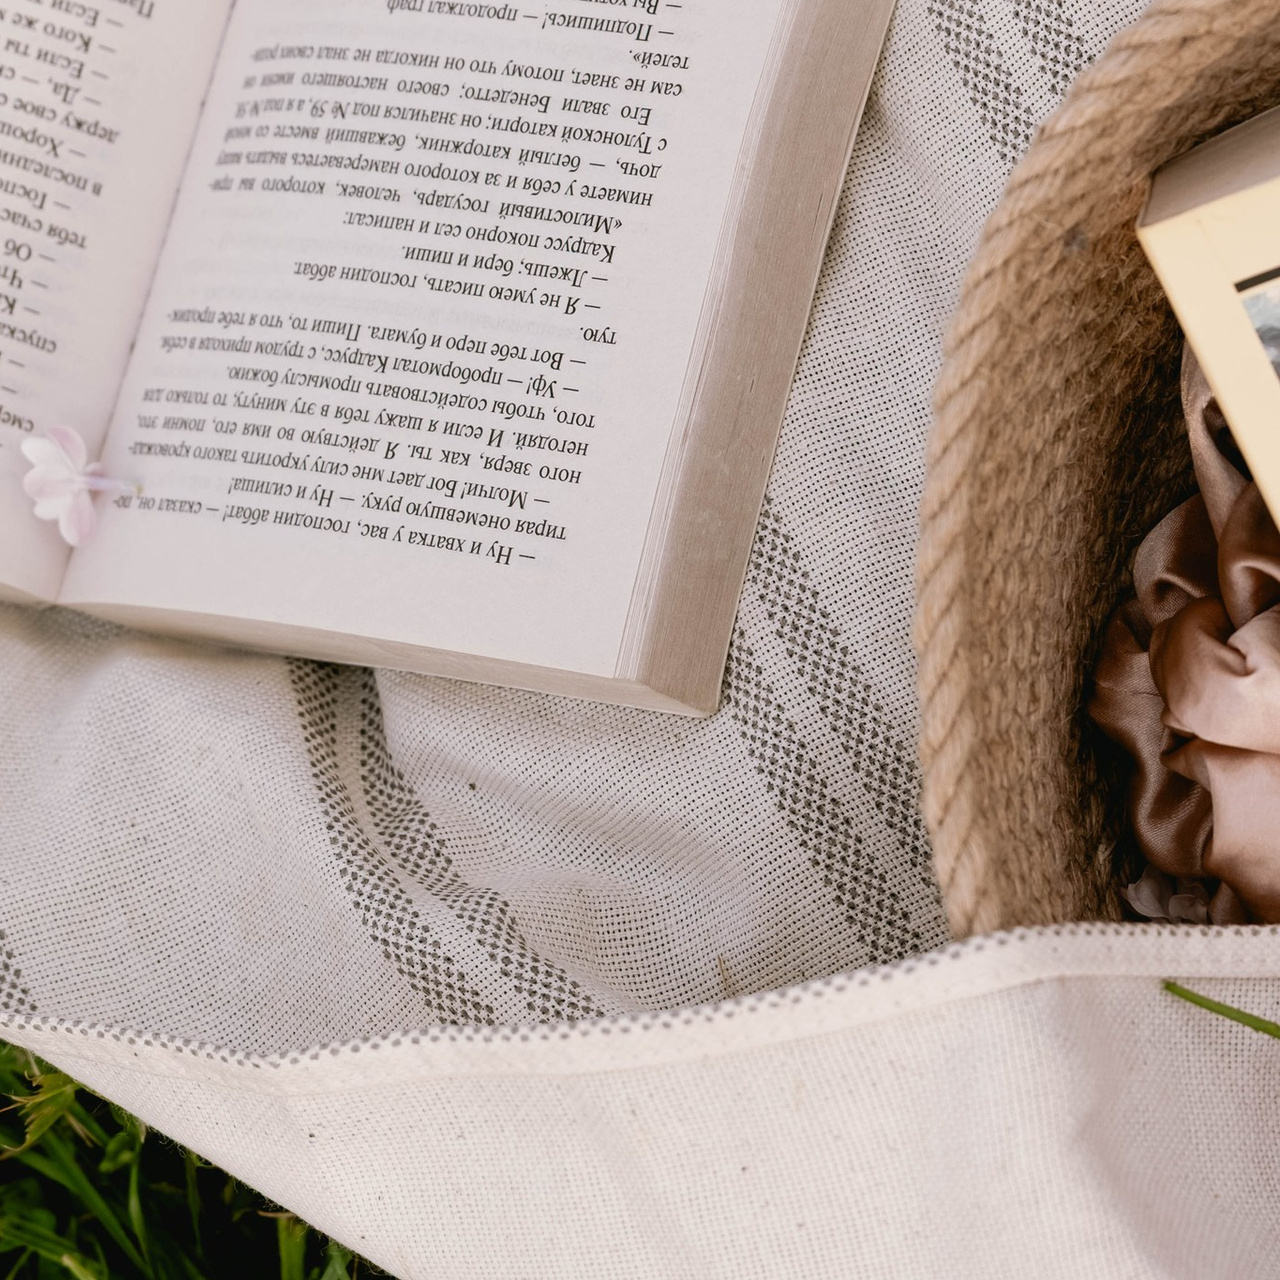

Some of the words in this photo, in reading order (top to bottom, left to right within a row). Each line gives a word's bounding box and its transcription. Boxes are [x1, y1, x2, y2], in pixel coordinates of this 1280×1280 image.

[11, 12, 38, 29] же
[426, 0, 518, 21] продолжал
[42, 22, 92, 53] Кого
[540, 11, 653, 42] Подпишись!
[3, 37, 29, 57] ты
[35, 48, 84, 79] Если
[468, 59, 497, 74] что
[628, 49, 689, 69] телей».
[500, 59, 564, 82] потому
[570, 68, 620, 89] знает,
[47, 77, 80, 105] Да,
[396, 79, 450, 96] своего
[458, 83, 551, 113] Бенедетто;
[649, 80, 682, 96] сам
[12, 97, 57, 121] свое
[382, 105, 457, 125] значился
[560, 97, 611, 116] звали
[619, 104, 652, 126] Его
[63, 113, 120, 144] держу
[484, 115, 558, 137] каторги;
[414, 134, 511, 159] каторжник,
[560, 125, 652, 155] Тулонской
[517, 148, 581, 173] беглый
[615, 158, 662, 178] дочь,
[403, 162, 480, 184] которого
[521, 176, 561, 196] себя
[579, 184, 653, 206] нимаете
[412, 189, 489, 213] государь,
[433, 221, 462, 237] сел
[498, 202, 622, 234] «Милостивый
[45, 223, 86, 249] тебя
[464, 224, 540, 248] покорно
[3, 238, 32, 262] Об
[401, 245, 454, 264] пиши.
[543, 235, 616, 264] Кадрусс
[472, 252, 514, 277] бери
[517, 258, 588, 288] Лжешь;
[338, 266, 417, 288] господин
[423, 274, 485, 297] писать,
[488, 285, 537, 304] умею
[367, 325, 427, 350] бумага.
[444, 334, 487, 354] перо
[579, 326, 616, 345] тую.
[320, 346, 389, 374] Кадрусс,
[489, 342, 527, 362] тебе
[529, 348, 564, 370] Вот
[391, 356, 503, 385] пробормотал
[364, 381, 488, 411] содействовать
[333, 405, 369, 424] тебя
[373, 407, 423, 430] щажу
[490, 399, 545, 420] чтобы
[552, 405, 595, 428] того,
[300, 427, 380, 453] действую
[442, 420, 483, 439] если
[512, 431, 589, 456] негодяй.
[309, 455, 349, 476] силу
[438, 449, 471, 466] как
[479, 452, 532, 476] зверя,
[351, 464, 385, 482] мне
[386, 470, 426, 488] дает
[538, 464, 582, 484] ного
[425, 476, 458, 498] Бог
[459, 481, 528, 510] Молчи!
[360, 491, 403, 513] руку.
[272, 510, 351, 534] господин
[405, 500, 511, 530] онемевшую
[356, 520, 389, 540] вас,
[514, 518, 566, 540] тирая
[407, 530, 466, 552] хватка
